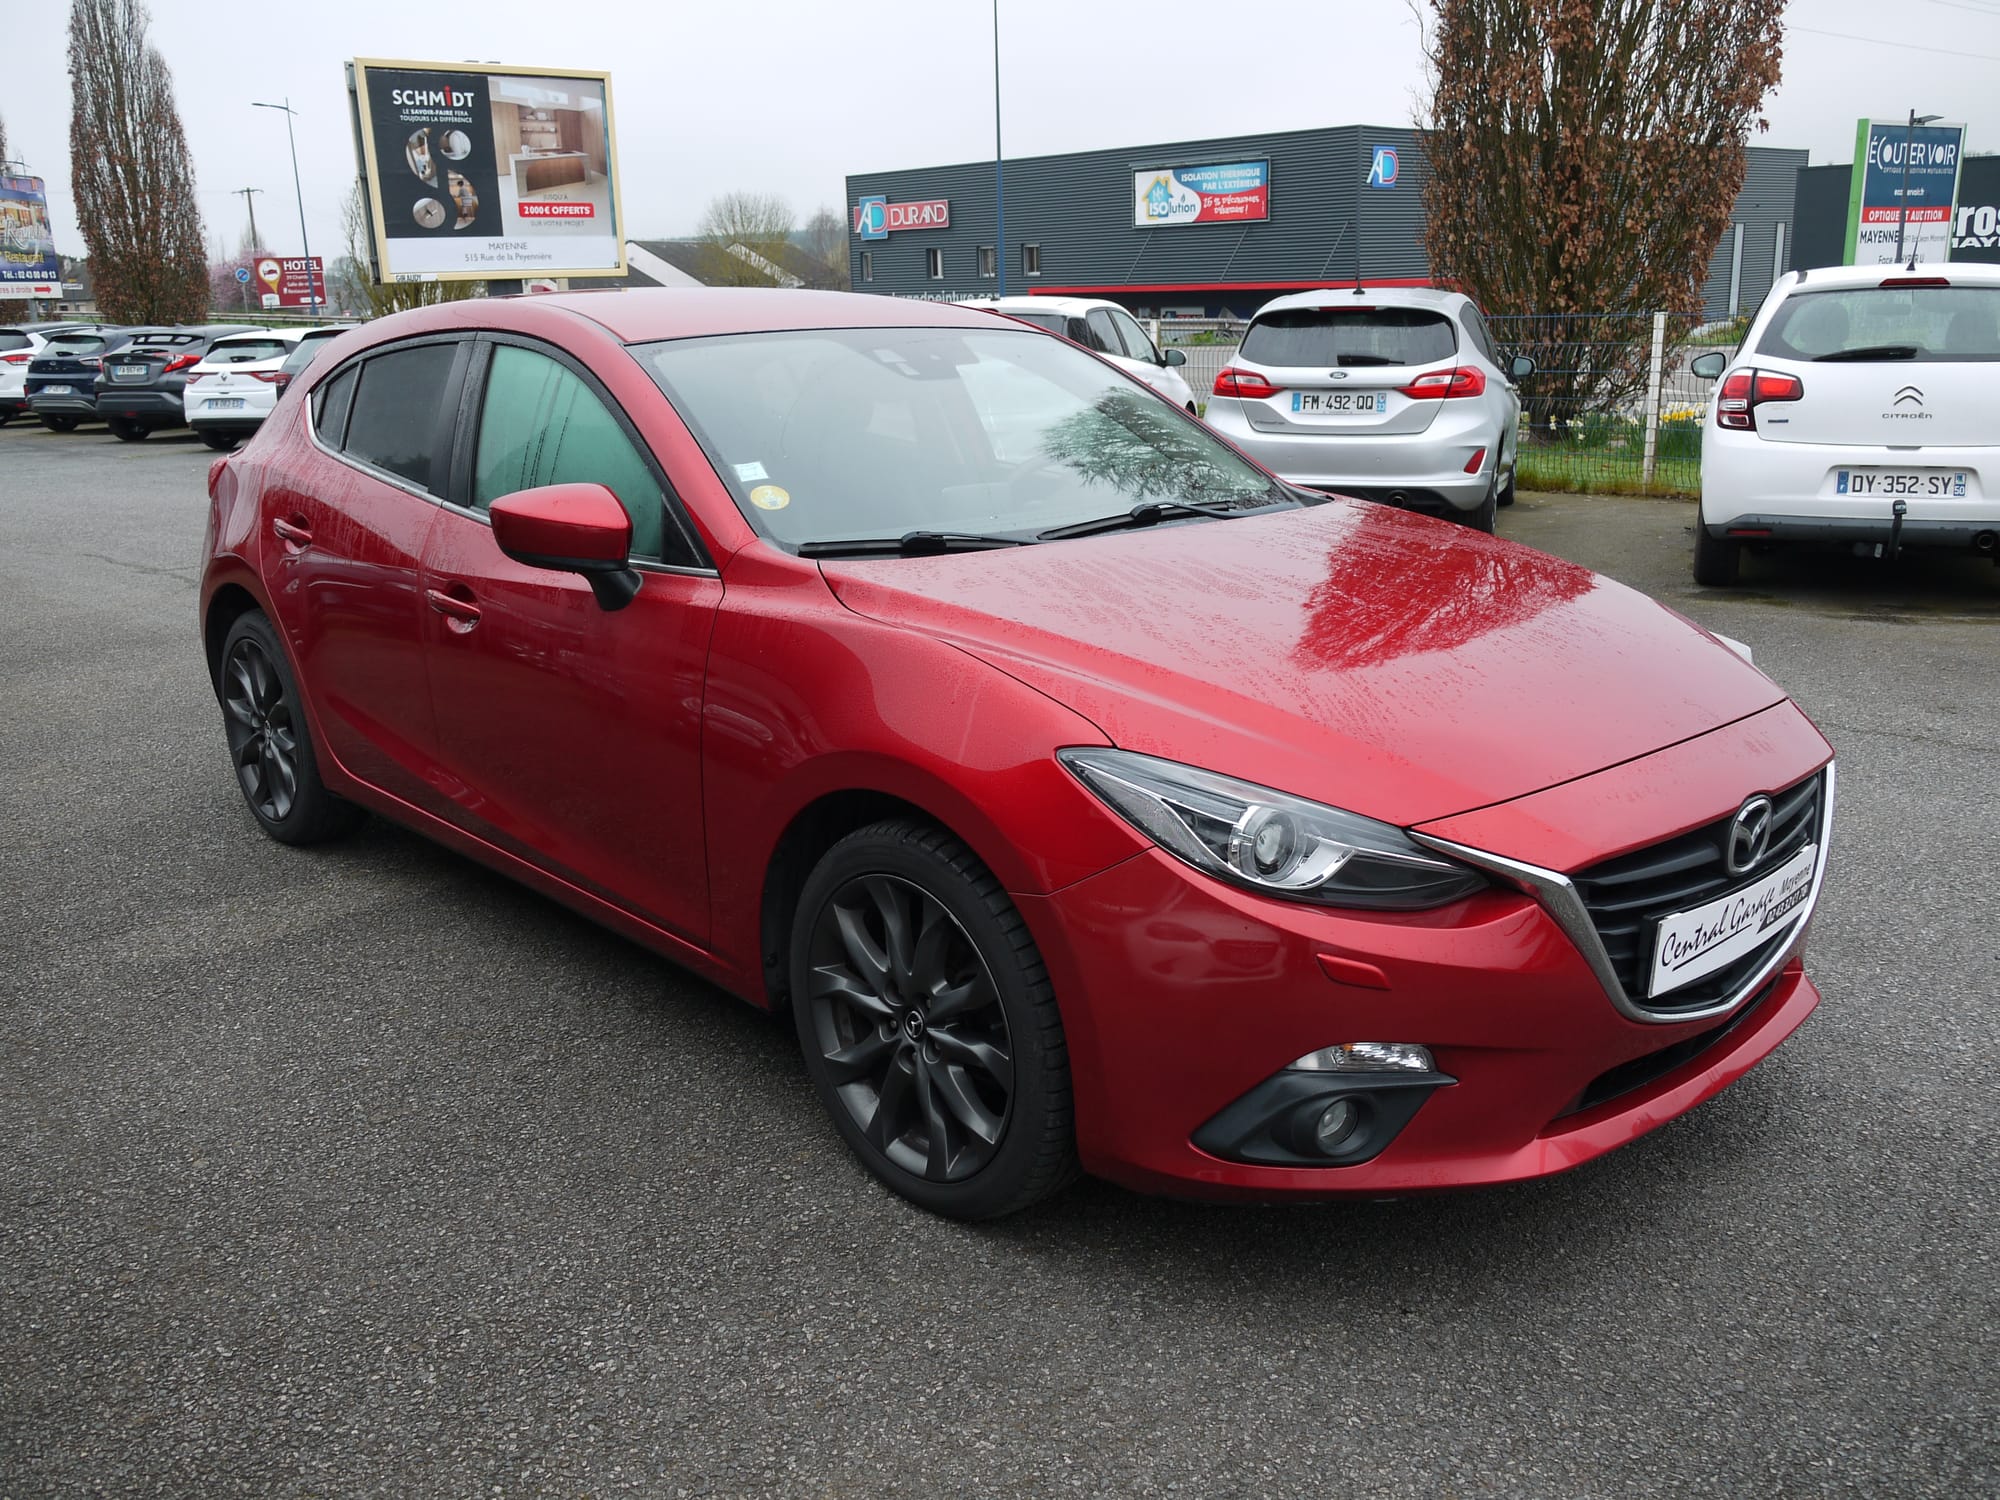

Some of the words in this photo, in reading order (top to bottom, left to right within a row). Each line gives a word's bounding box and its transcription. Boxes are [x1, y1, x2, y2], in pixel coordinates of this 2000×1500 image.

[1928, 144, 1956, 165] VOIR
[1181, 172, 1218, 182] ISOLATION
[1202, 182, 1217, 191] PAR
[551, 206, 591, 215] OFFERTS
[890, 204, 947, 226] DURAND
[1868, 210, 1900, 221] OPTIQUE
[1860, 230, 1899, 243] MAYENNE
[488, 242, 528, 250] MAYENNE
[481, 253, 495, 261] Rue
[497, 253, 505, 261] de
[507, 253, 514, 261] la
[1302, 395, 1374, 410] FM-492-QQ
[1852, 475, 1952, 495] DY-352-SY
[1662, 904, 1727, 967] Central
